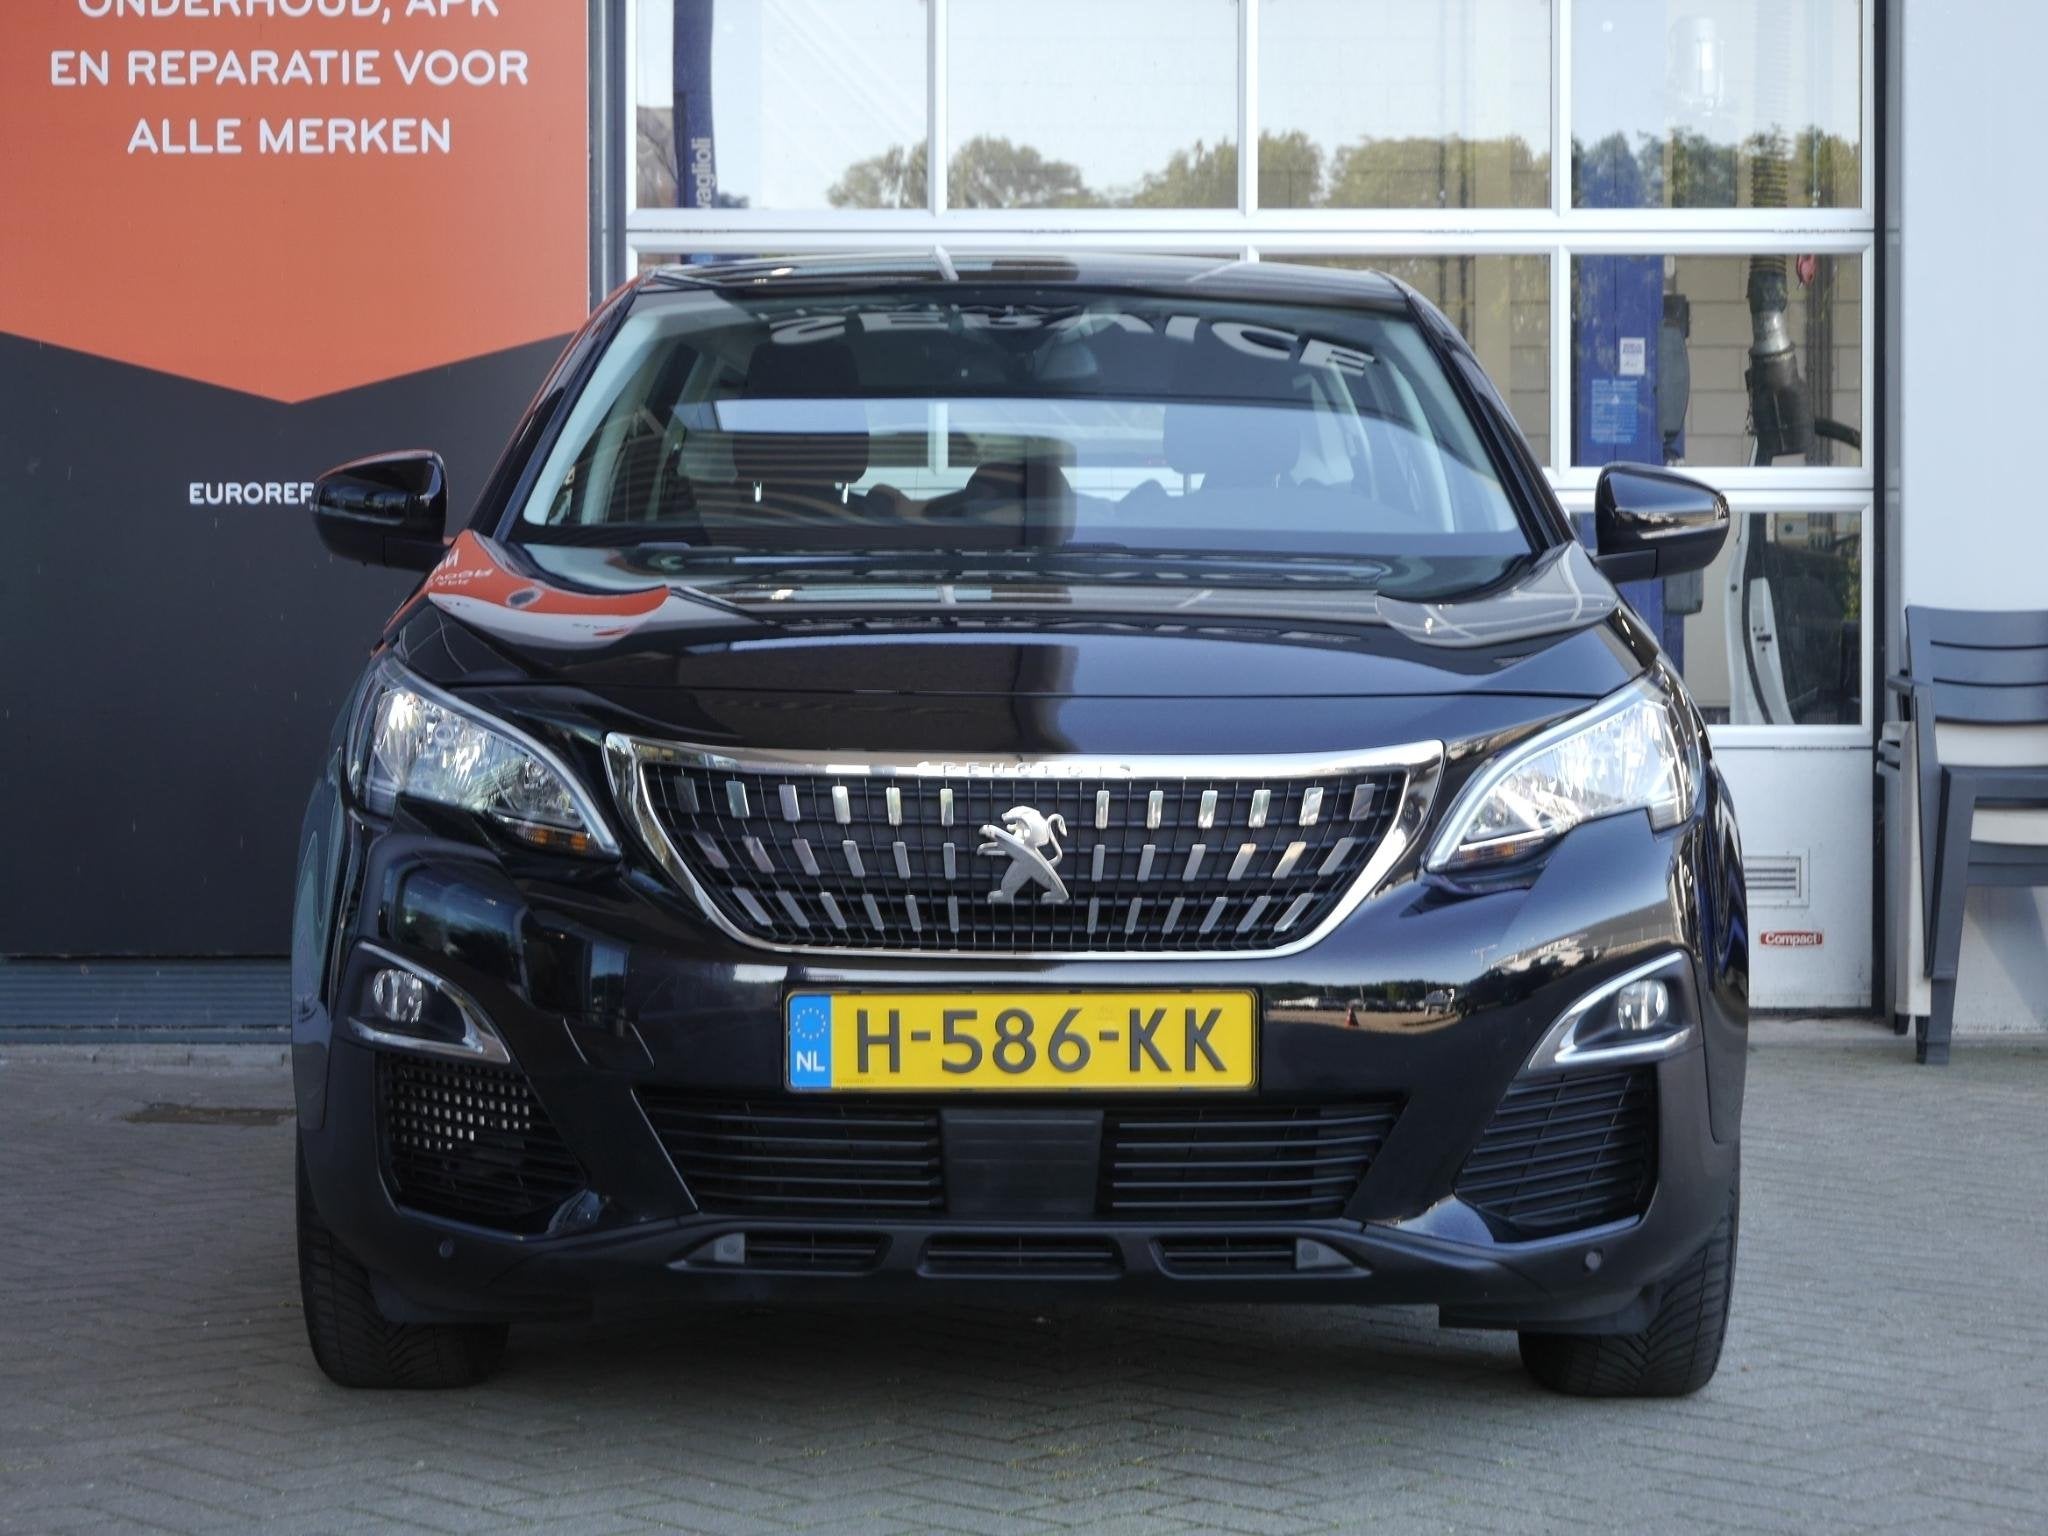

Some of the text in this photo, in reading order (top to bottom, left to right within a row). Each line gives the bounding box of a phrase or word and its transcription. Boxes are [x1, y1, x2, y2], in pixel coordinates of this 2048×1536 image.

[50, 49, 529, 87] EN REPARATIE VOOR
[126, 117, 451, 155] ALLE MERKEN
[1764, 933, 1818, 947] Compact
[796, 1008, 1227, 1074] NL H-586-KK
